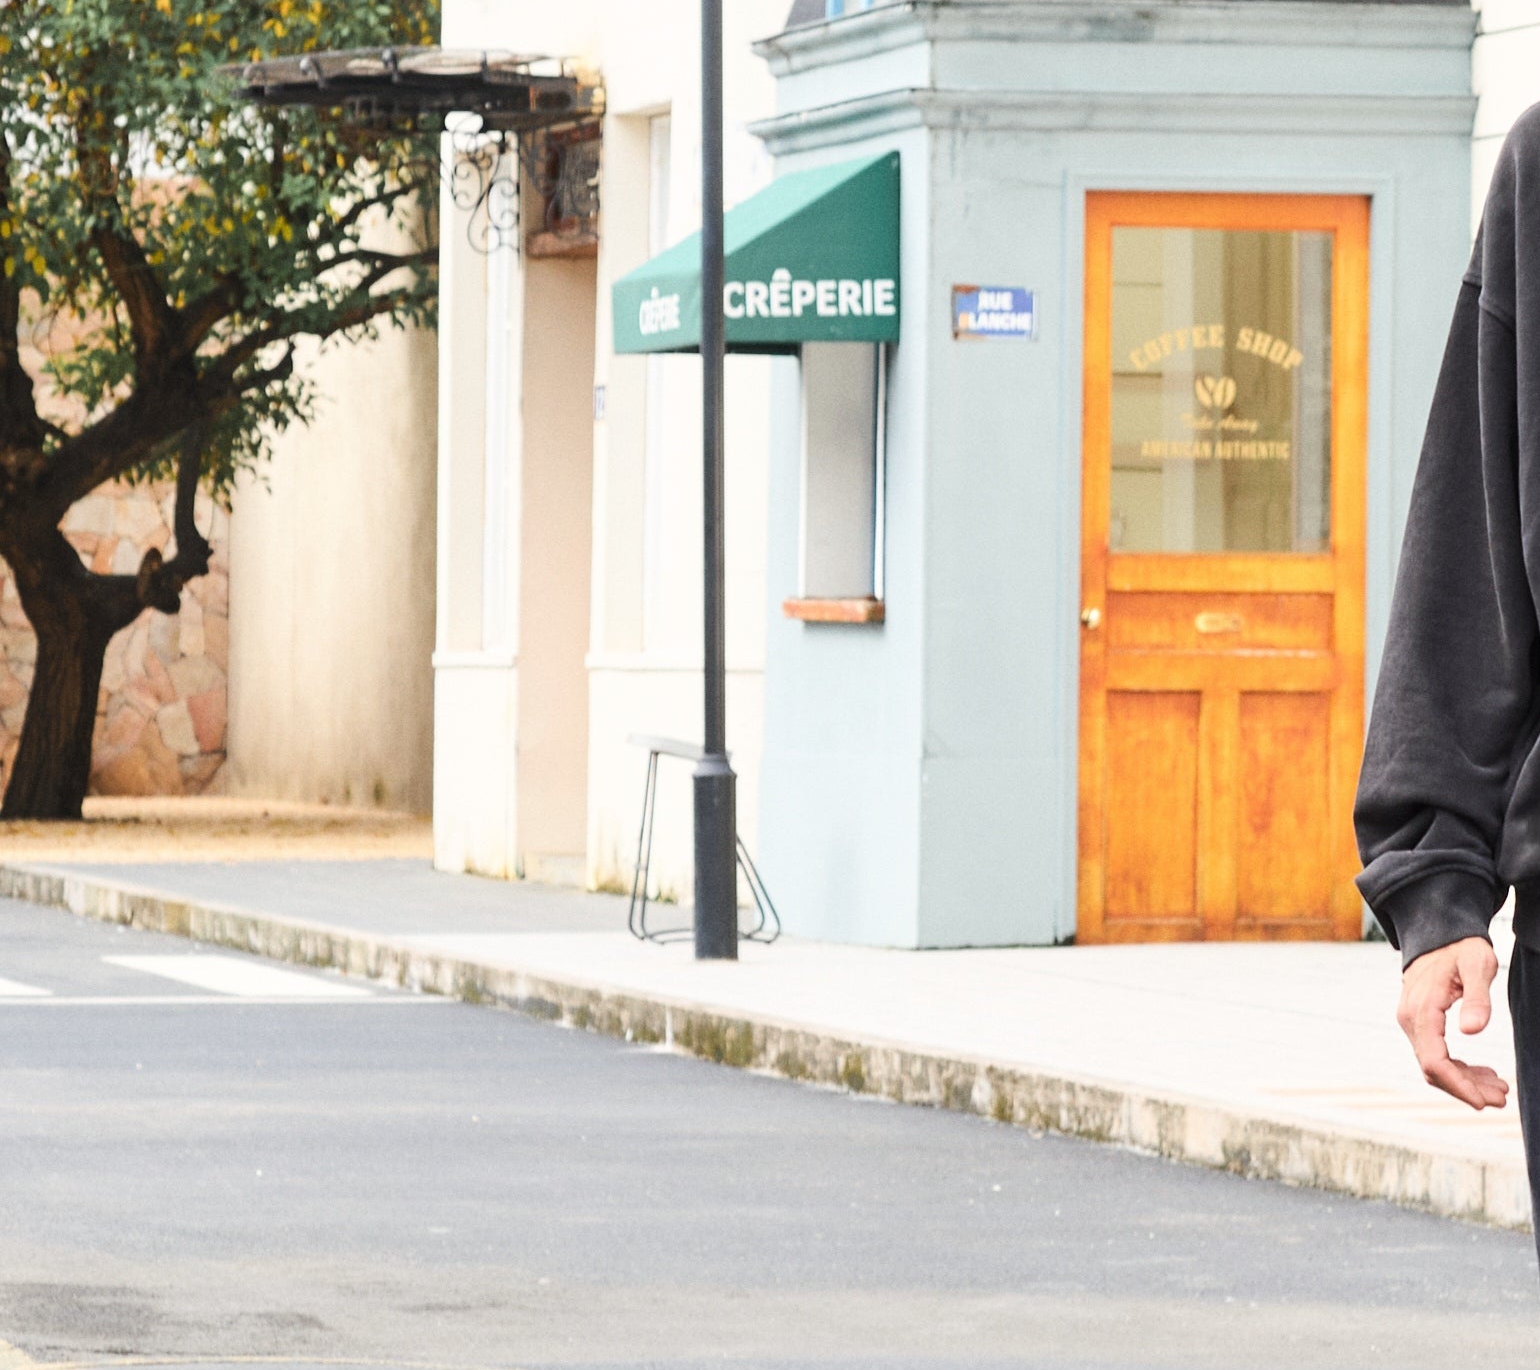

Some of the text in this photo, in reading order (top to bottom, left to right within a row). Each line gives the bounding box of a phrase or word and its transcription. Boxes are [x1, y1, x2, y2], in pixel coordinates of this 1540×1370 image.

[723, 268, 896, 318] CRÊPERIE
[978, 291, 1012, 311] RUE
[1129, 324, 1304, 372] COFFEE SHOP
